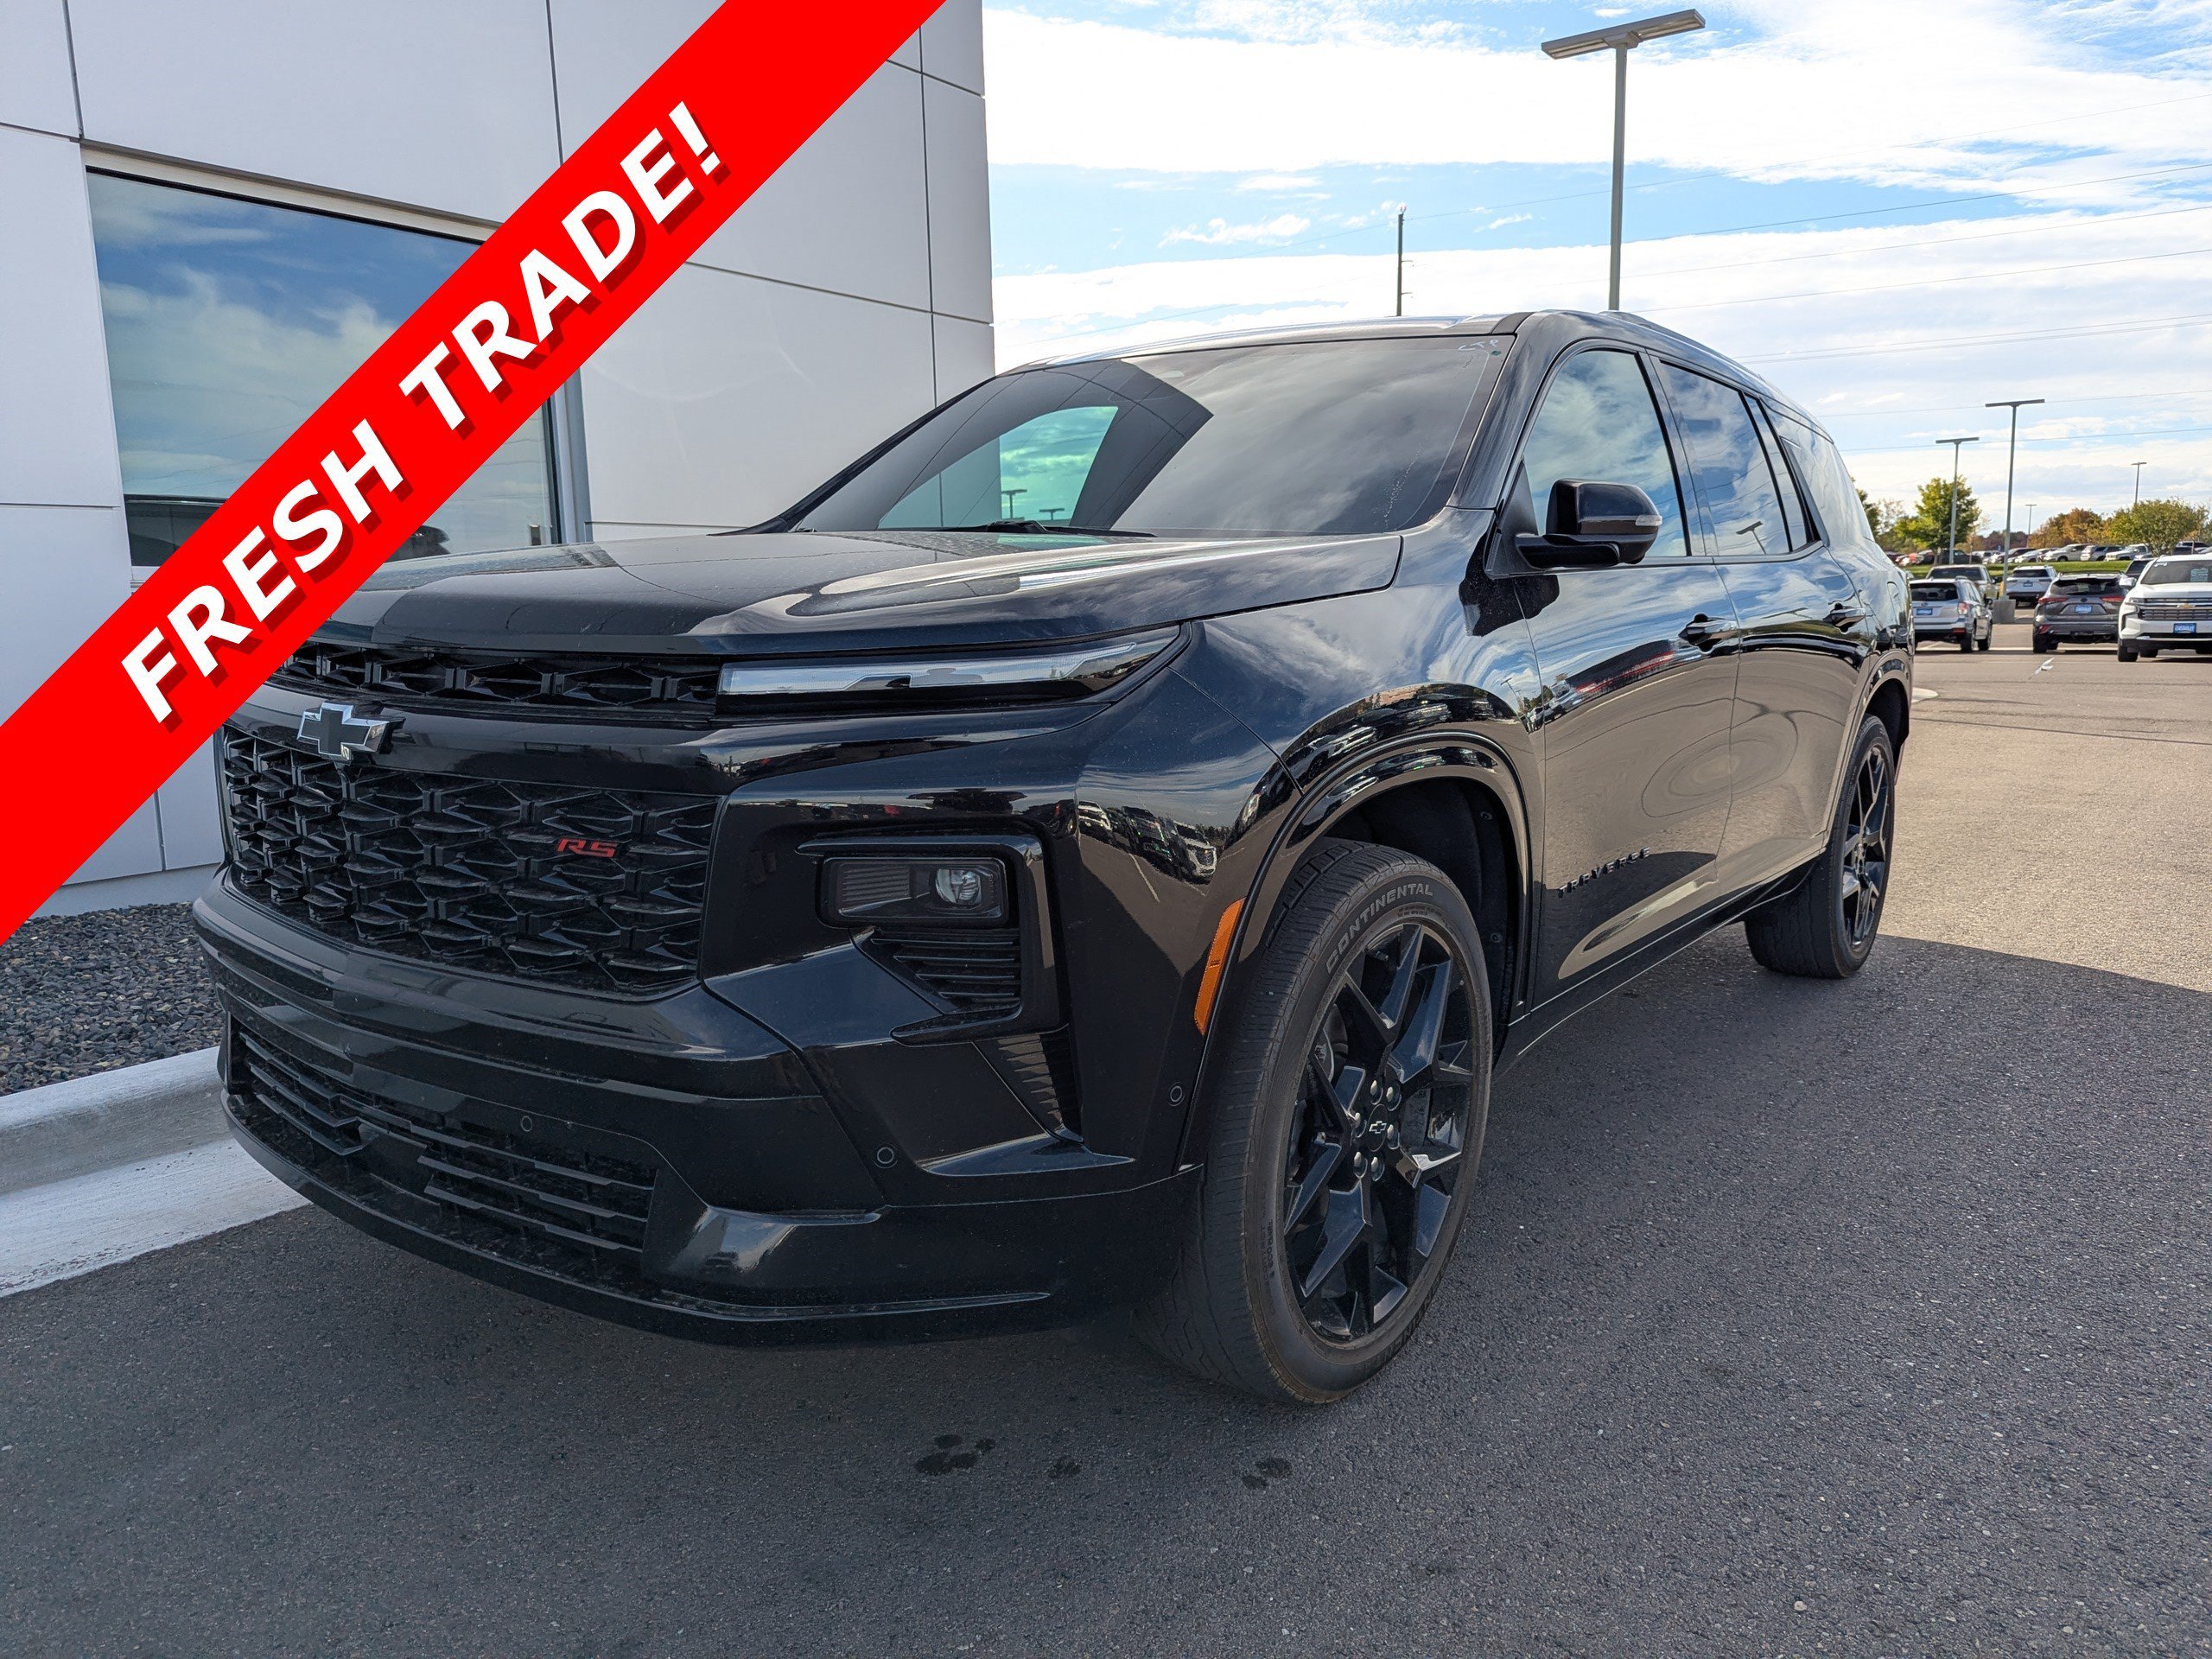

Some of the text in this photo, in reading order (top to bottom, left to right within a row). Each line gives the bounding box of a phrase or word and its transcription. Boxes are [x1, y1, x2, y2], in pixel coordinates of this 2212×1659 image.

[556, 836, 620, 858] RS
[1557, 847, 1651, 899] TRAVERSE
[1325, 882, 1434, 975] CONTINENTAL
